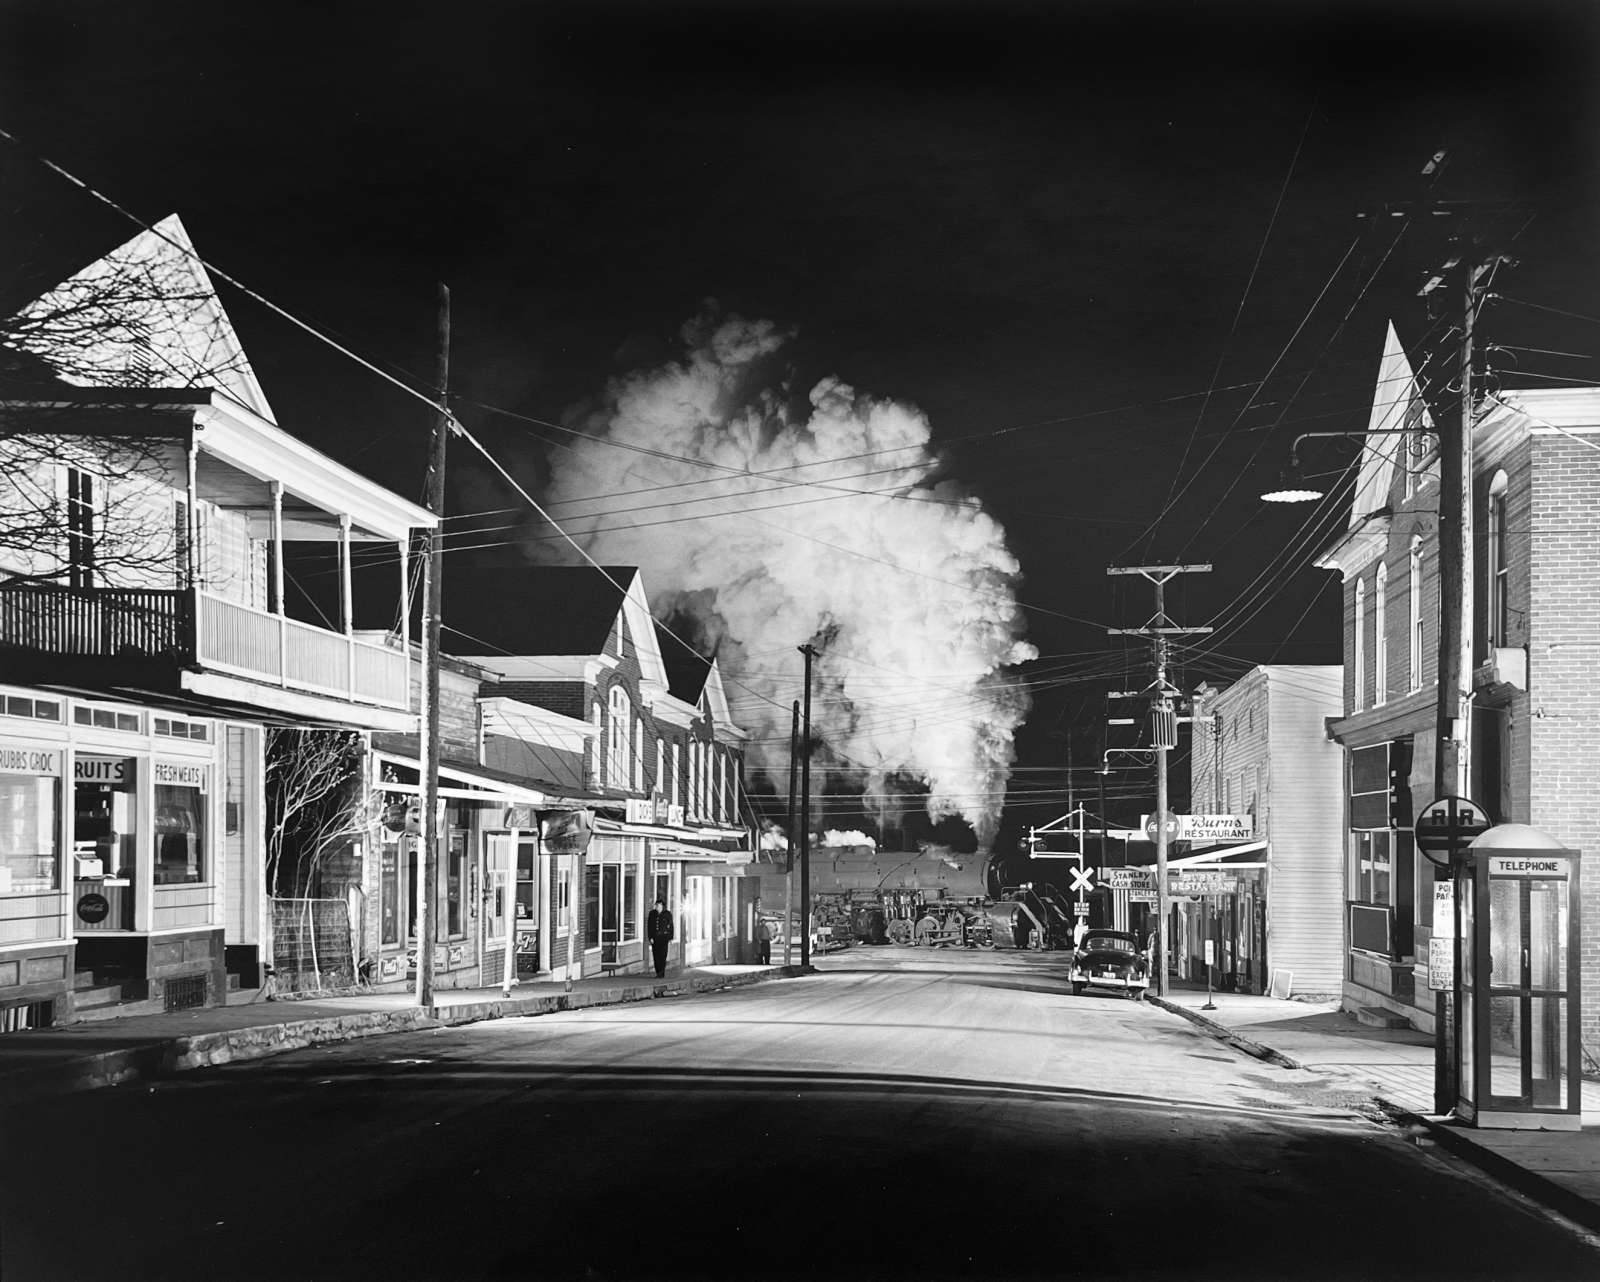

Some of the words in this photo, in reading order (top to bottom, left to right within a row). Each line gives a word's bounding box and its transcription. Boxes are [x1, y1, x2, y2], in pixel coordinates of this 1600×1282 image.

[74, 760, 124, 780] RUITS
[155, 763, 178, 782] FRESH
[178, 766, 200, 784] MEATS
[1191, 815, 1244, 828] Burns
[1432, 809, 1446, 826] R
[1460, 809, 1474, 826] R
[1184, 828, 1251, 838] RESTAURANT
[1499, 861, 1559, 872] TELEPHONE
[1111, 880, 1129, 888] CASH
[1130, 881, 1151, 889] STORE
